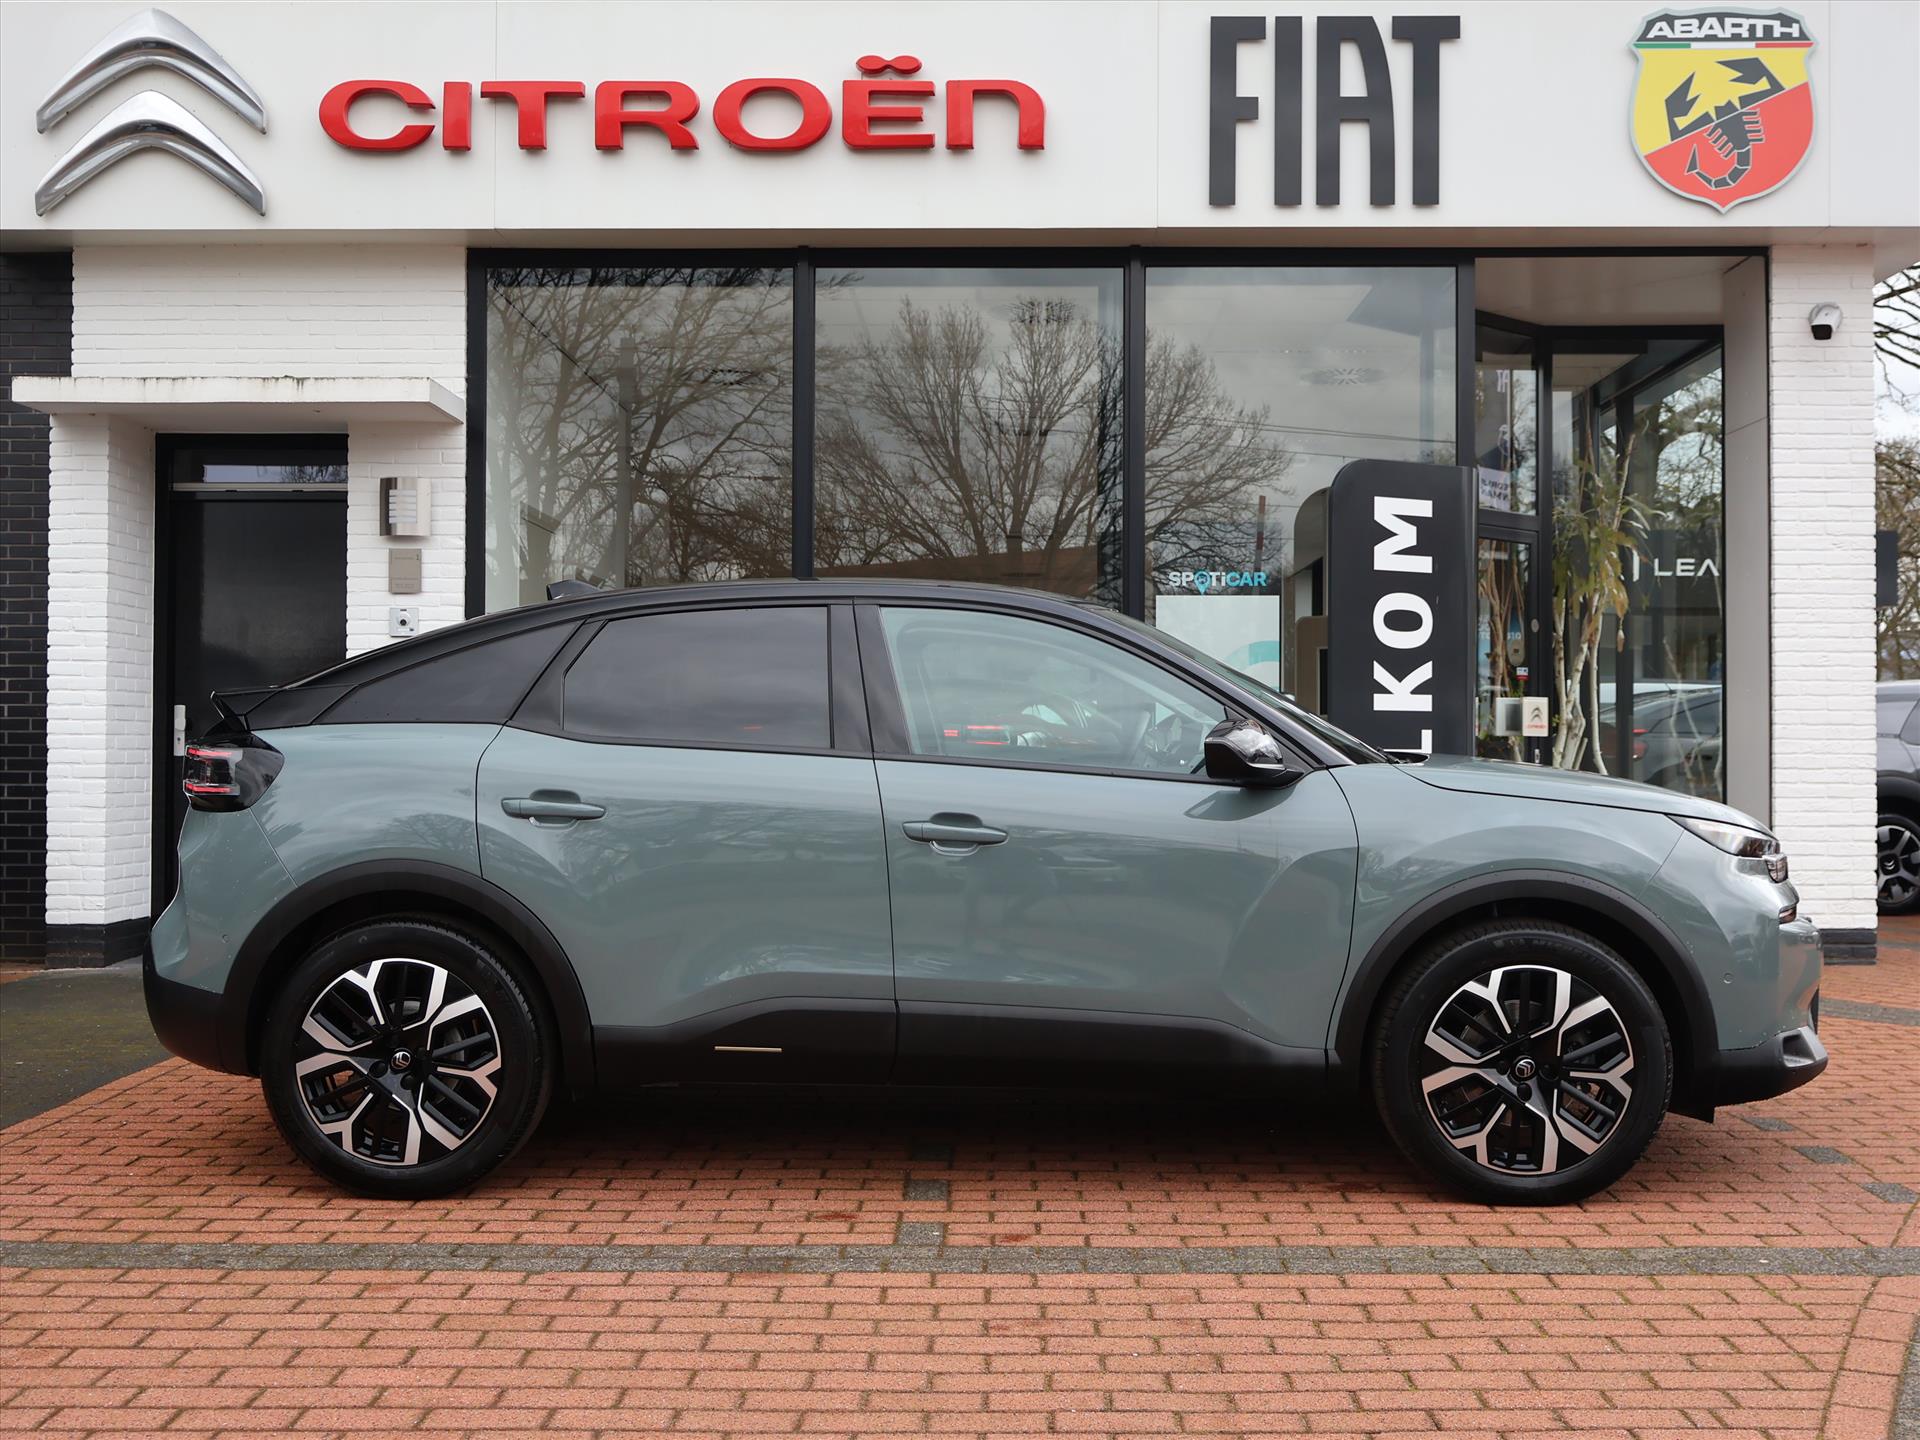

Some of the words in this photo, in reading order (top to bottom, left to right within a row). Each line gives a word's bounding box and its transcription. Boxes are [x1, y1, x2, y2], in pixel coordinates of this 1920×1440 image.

[1646, 17, 1800, 38] ABARTH
[319, 54, 1046, 153] CITROËN
[1209, 16, 1461, 207] FIAT
[1372, 495, 1434, 754] LKOM
